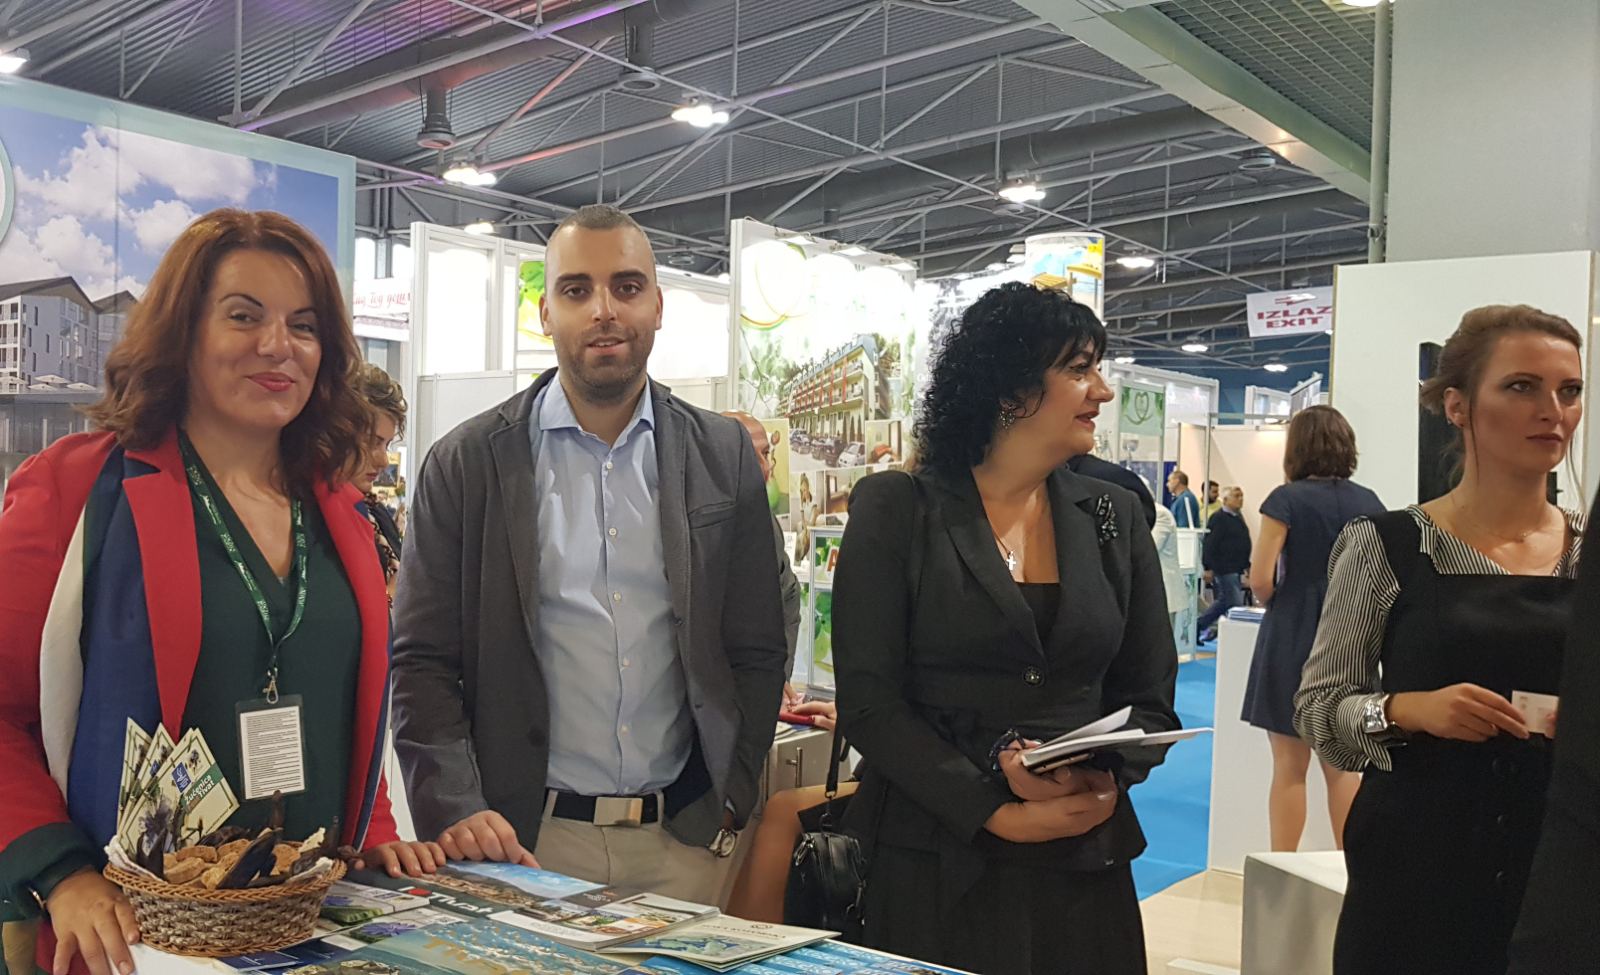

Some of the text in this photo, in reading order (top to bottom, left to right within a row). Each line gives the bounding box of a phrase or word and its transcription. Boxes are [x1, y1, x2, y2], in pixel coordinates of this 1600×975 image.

[1257, 307, 1332, 319] IZLAZ
[1266, 317, 1323, 328] EXIT
[198, 780, 215, 798] Tivat
[429, 891, 494, 913] Tivat
